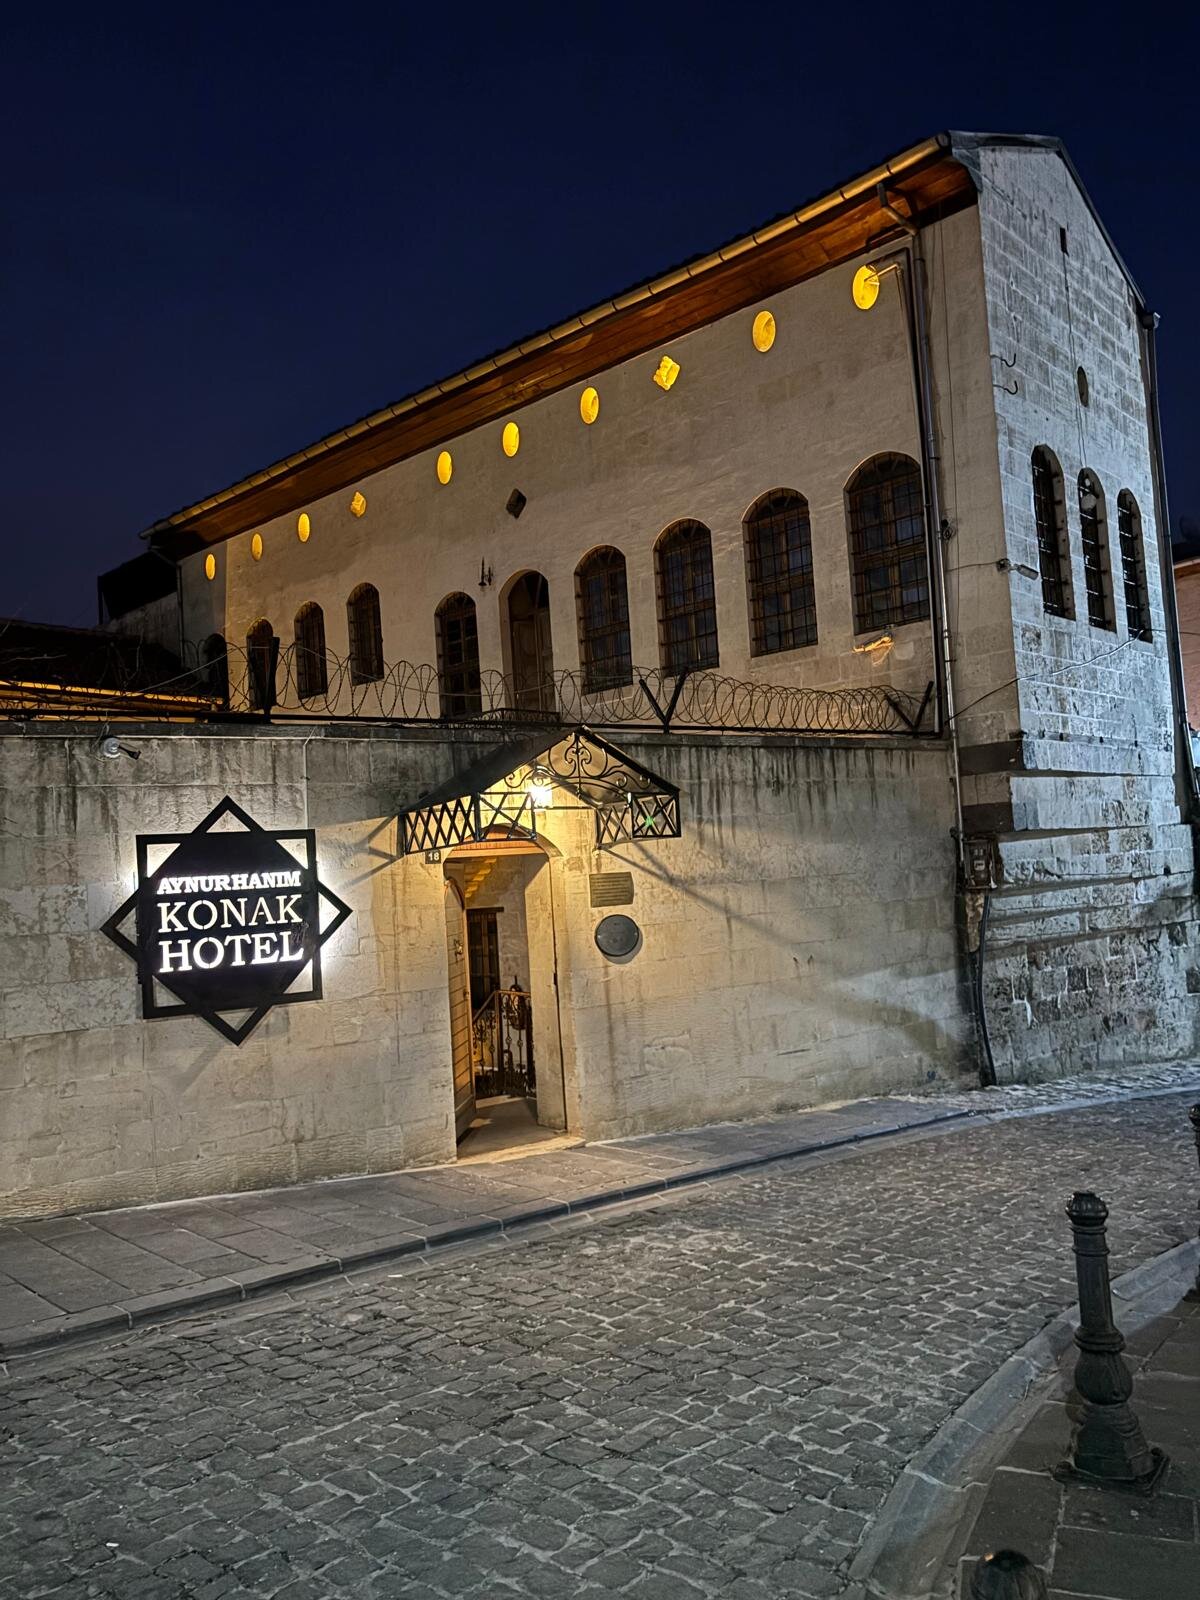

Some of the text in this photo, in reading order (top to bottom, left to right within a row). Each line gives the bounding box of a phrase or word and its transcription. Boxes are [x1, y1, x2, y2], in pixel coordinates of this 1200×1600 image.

[428, 852, 440, 861] 18
[157, 894, 303, 933] KONAK
[158, 931, 304, 973] HOTEL
